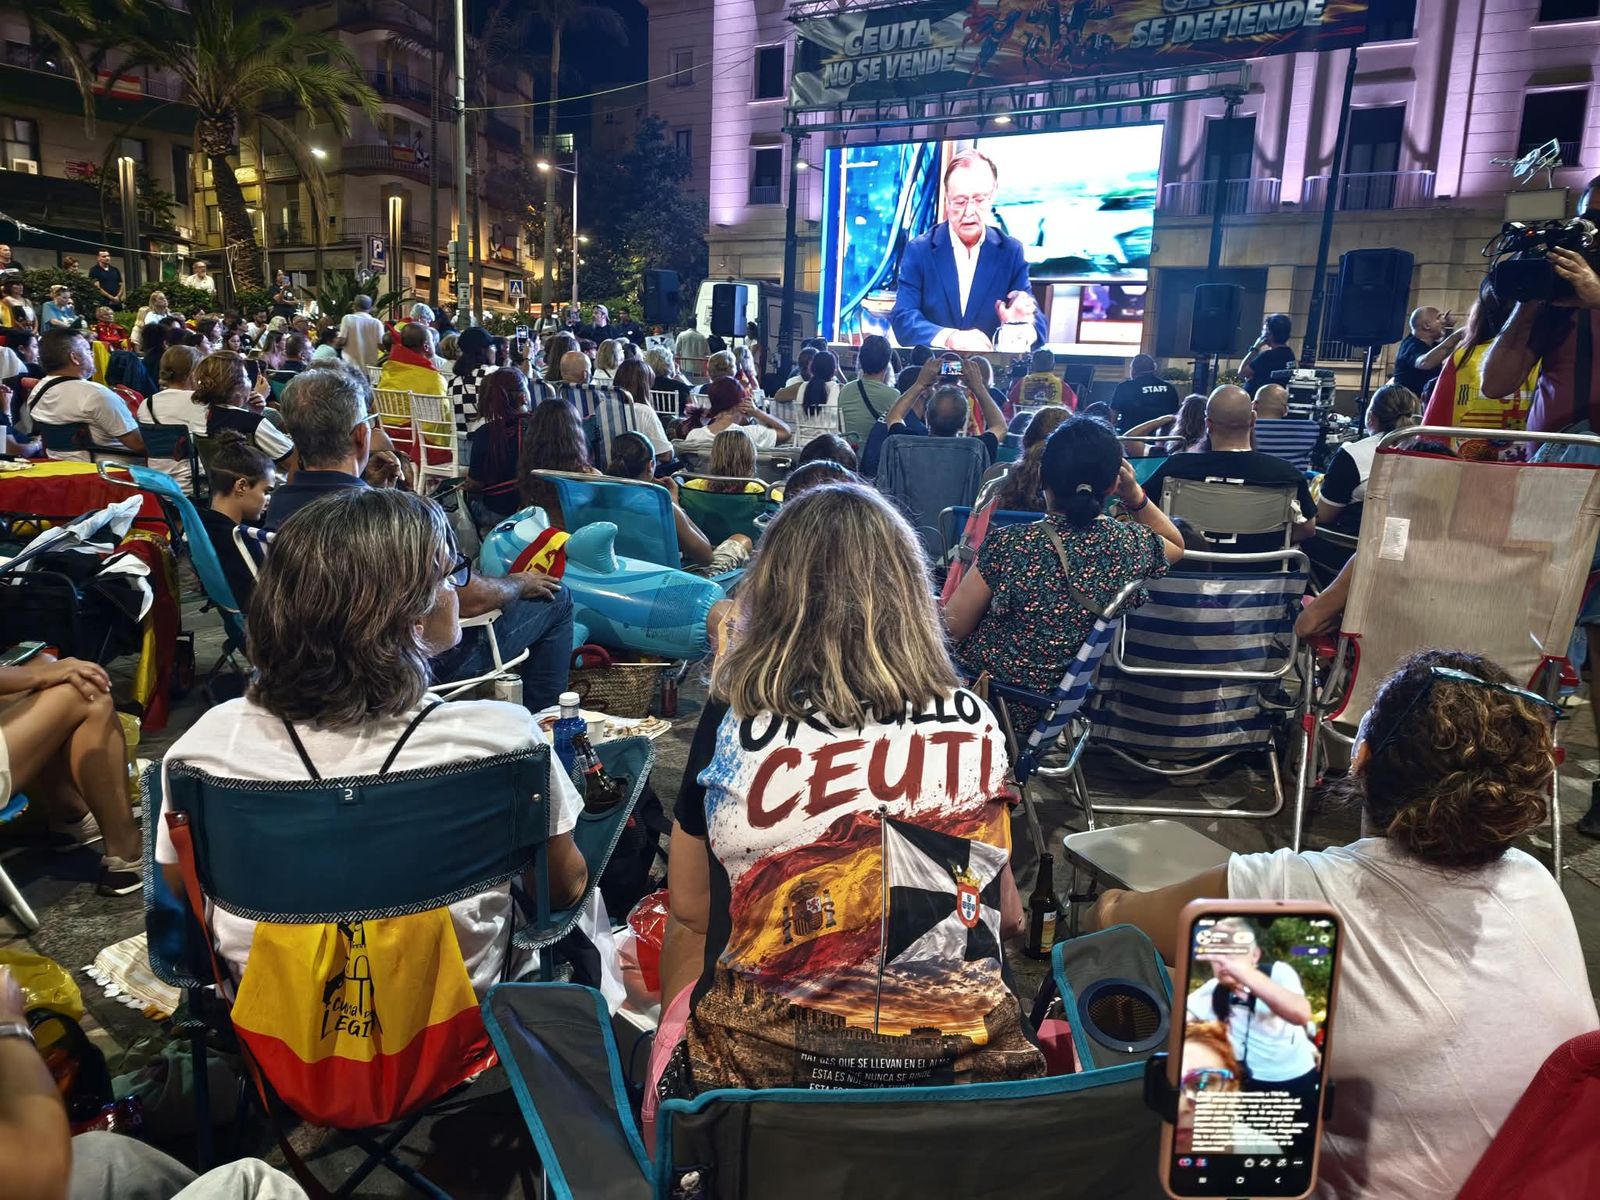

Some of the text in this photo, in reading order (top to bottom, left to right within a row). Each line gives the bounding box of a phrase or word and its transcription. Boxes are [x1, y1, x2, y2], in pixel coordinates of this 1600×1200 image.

[1130, 0, 1325, 48] SE DEFIENDE
[844, 18, 933, 57] CEUTA
[824, 48, 956, 88] NO SE VENDE
[1142, 385, 1168, 394] STAFF
[858, 1058, 869, 1068] SE
[871, 1058, 902, 1068] LLEVAN
[904, 1058, 916, 1068] EN
[811, 1068, 833, 1081] ESTA
[834, 1071, 845, 1082] ES
[865, 1073, 894, 1082] NUNCA
[896, 1073, 908, 1082] SE
